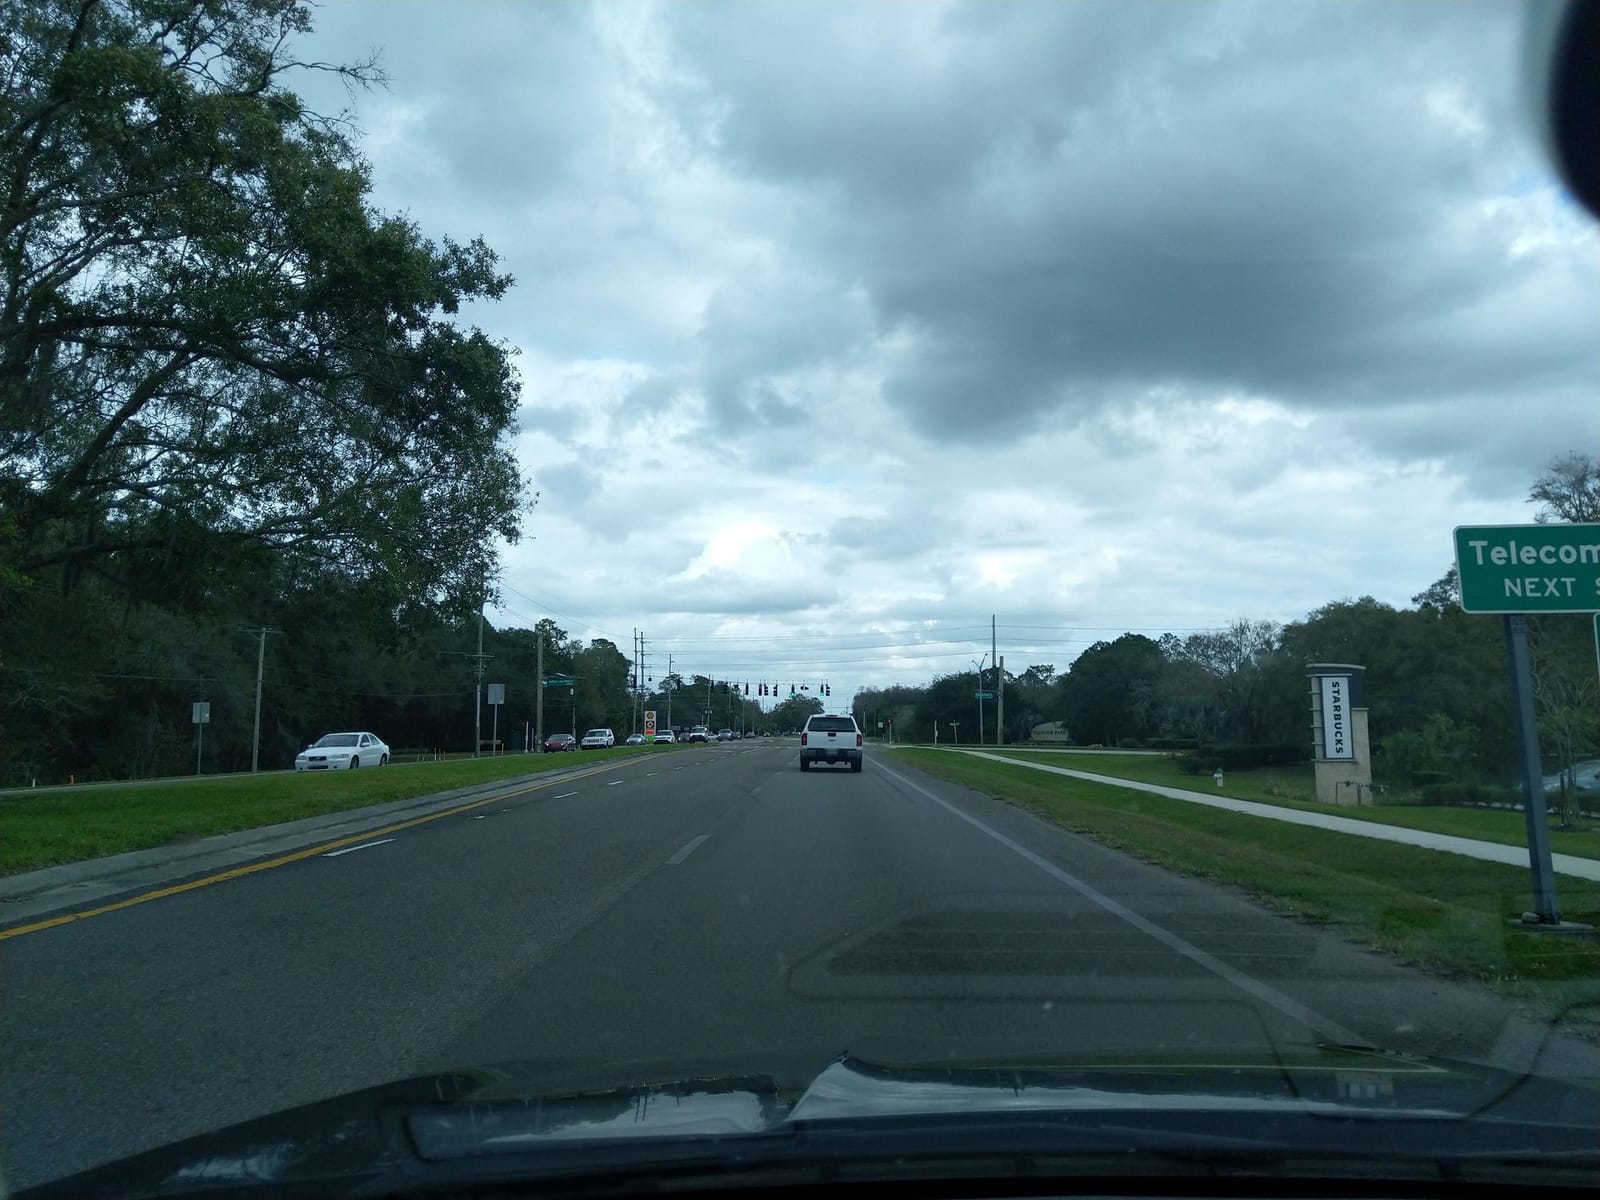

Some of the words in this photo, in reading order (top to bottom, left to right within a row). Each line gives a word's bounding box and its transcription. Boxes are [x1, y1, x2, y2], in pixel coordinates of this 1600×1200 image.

[1468, 540, 1600, 565] Telecom
[1504, 577, 1576, 597] NEXT
[1331, 681, 1344, 754] STARBUCKS
